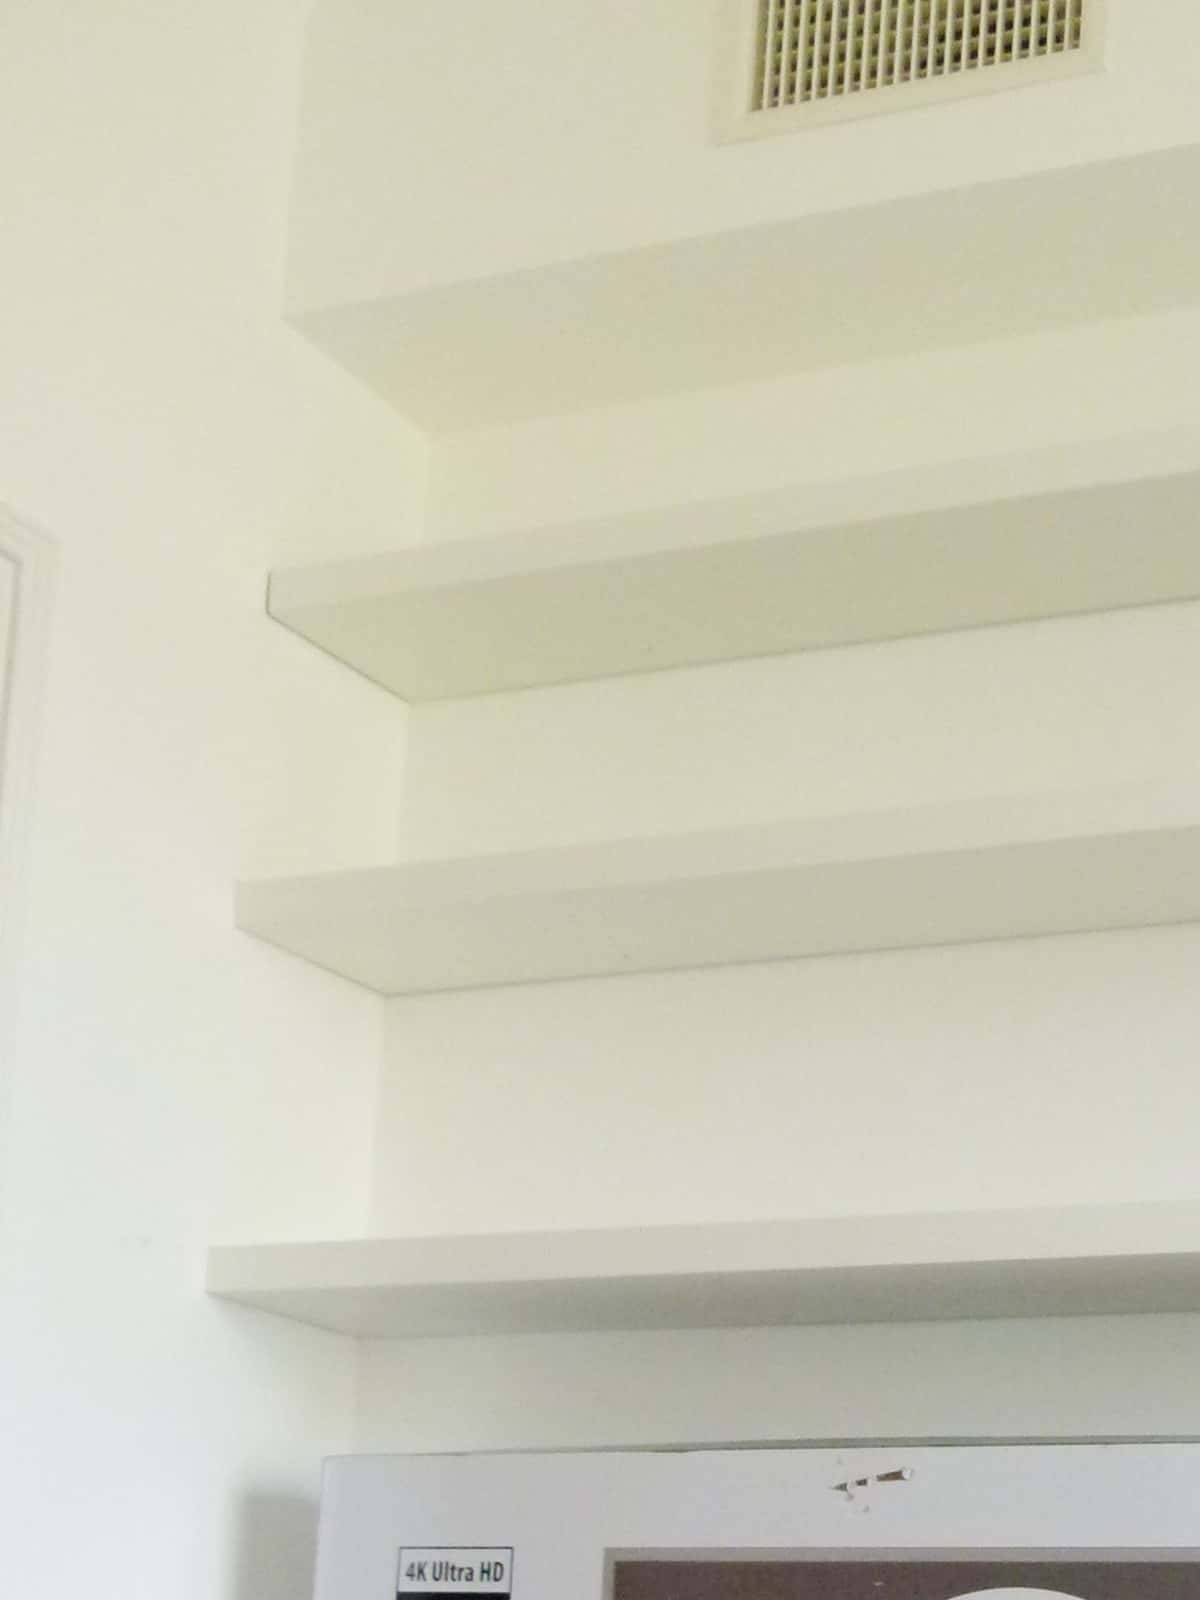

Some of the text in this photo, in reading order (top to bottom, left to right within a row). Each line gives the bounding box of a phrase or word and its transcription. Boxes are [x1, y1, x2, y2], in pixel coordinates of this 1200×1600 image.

[405, 1560, 504, 1582] 4K Ultra HD
